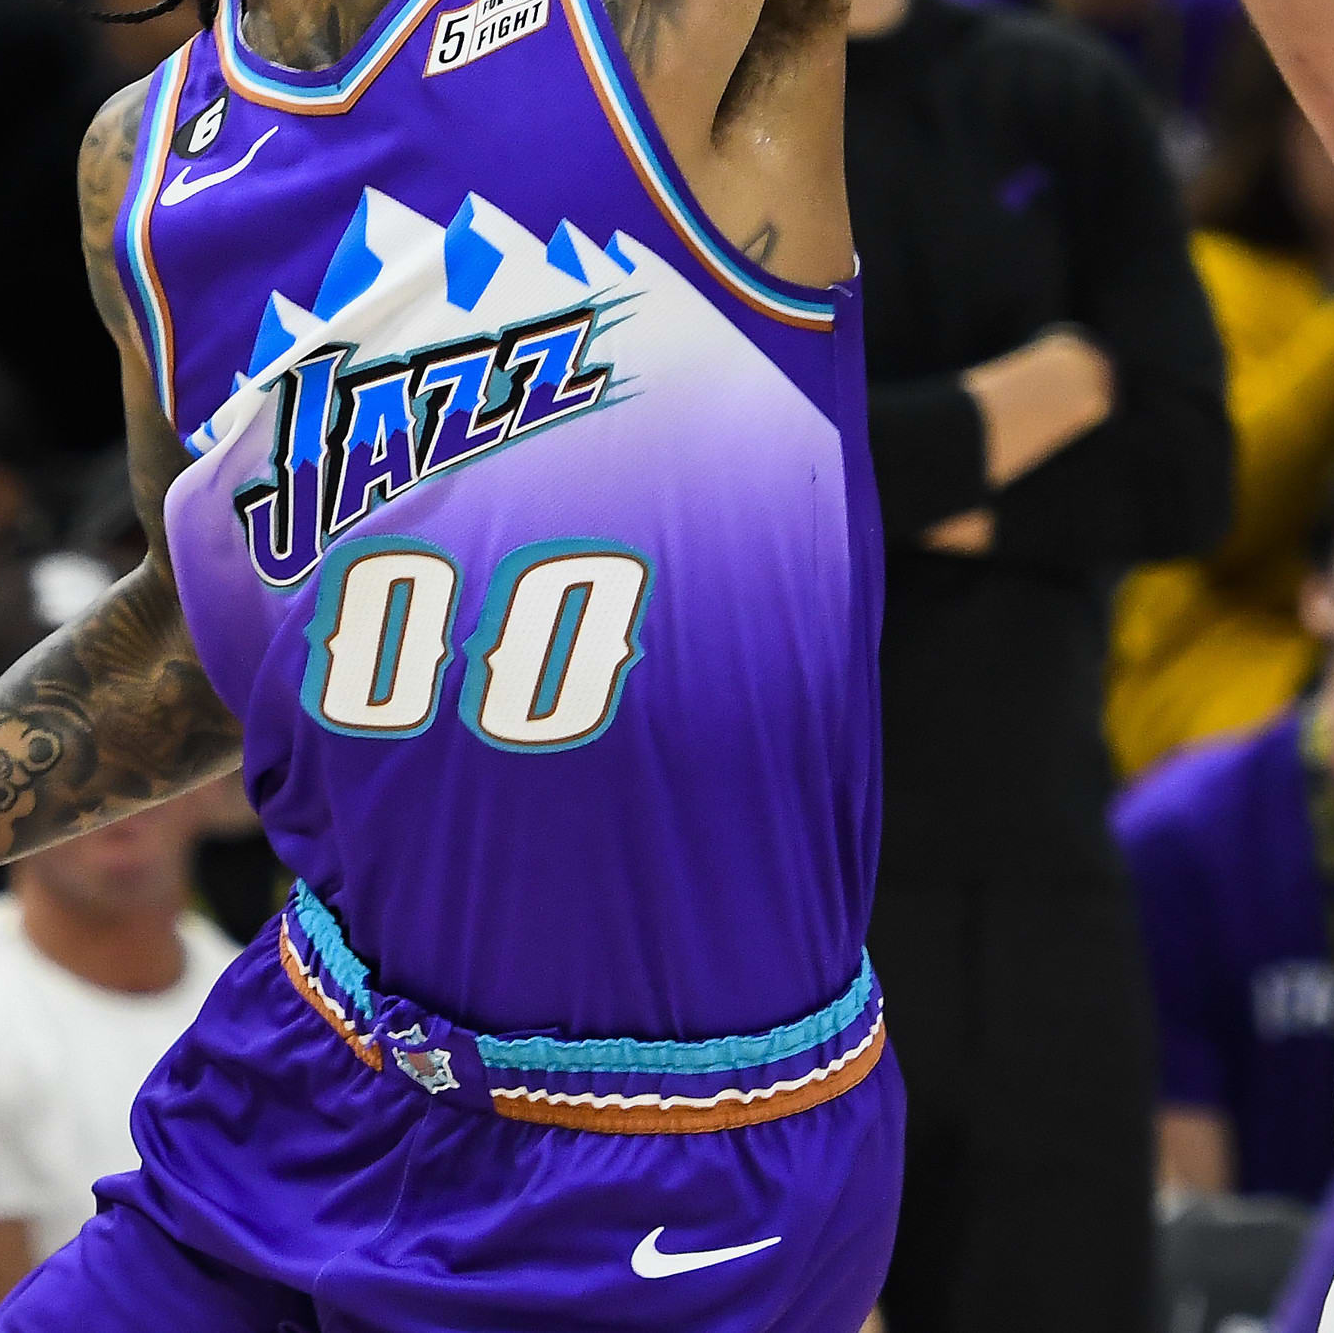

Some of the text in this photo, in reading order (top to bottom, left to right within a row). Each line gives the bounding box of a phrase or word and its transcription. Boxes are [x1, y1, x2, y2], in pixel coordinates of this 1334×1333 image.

[438, 14, 470, 64] 5
[476, 0, 543, 51] FIGHT
[187, 97, 227, 154] 6
[300, 534, 658, 755] 00
